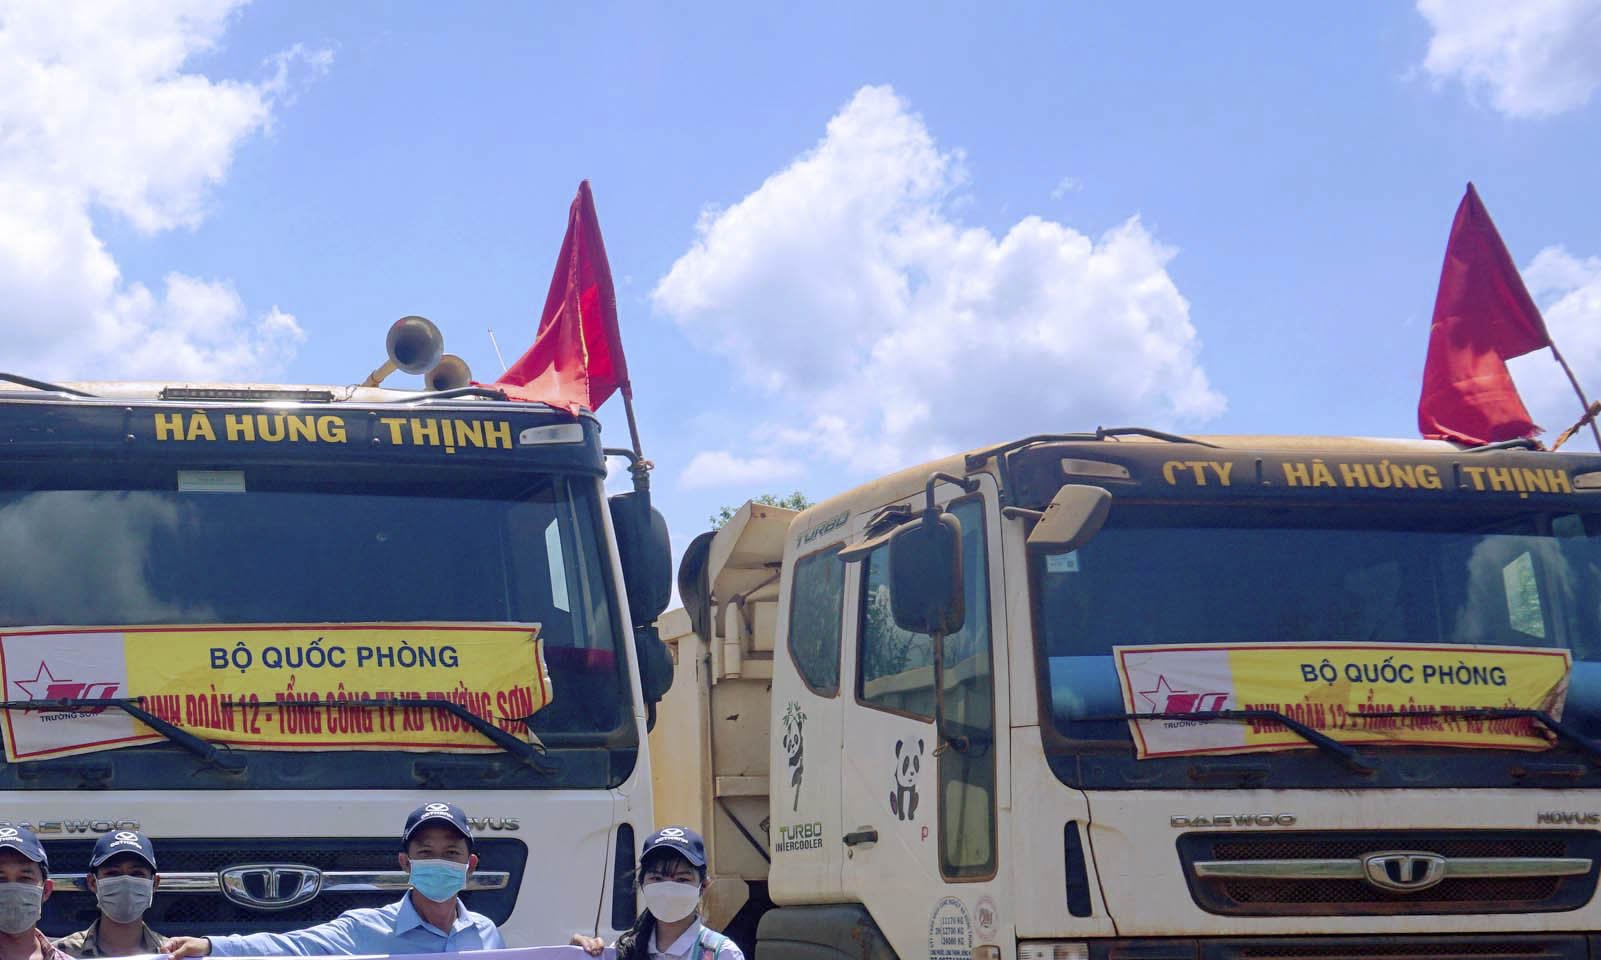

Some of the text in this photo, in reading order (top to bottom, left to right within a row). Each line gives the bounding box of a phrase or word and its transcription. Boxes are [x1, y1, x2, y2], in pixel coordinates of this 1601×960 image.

[154, 409, 513, 454] HÀ HƯNG THỊNH
[1162, 458, 1574, 498] CTY HÀ HƯNG THỊNH
[209, 637, 460, 674] BỘ QUỐC PHÒNG
[1300, 655, 1507, 687] BỘ QUỐC PHÒNG
[240, 692, 261, 735] 12
[275, 674, 322, 735] TỔNG
[325, 682, 374, 735] CÔNG
[780, 822, 823, 841] TURBO
[1170, 814, 1297, 828] DAEWOO
[775, 838, 823, 853] INTERCOOLER
